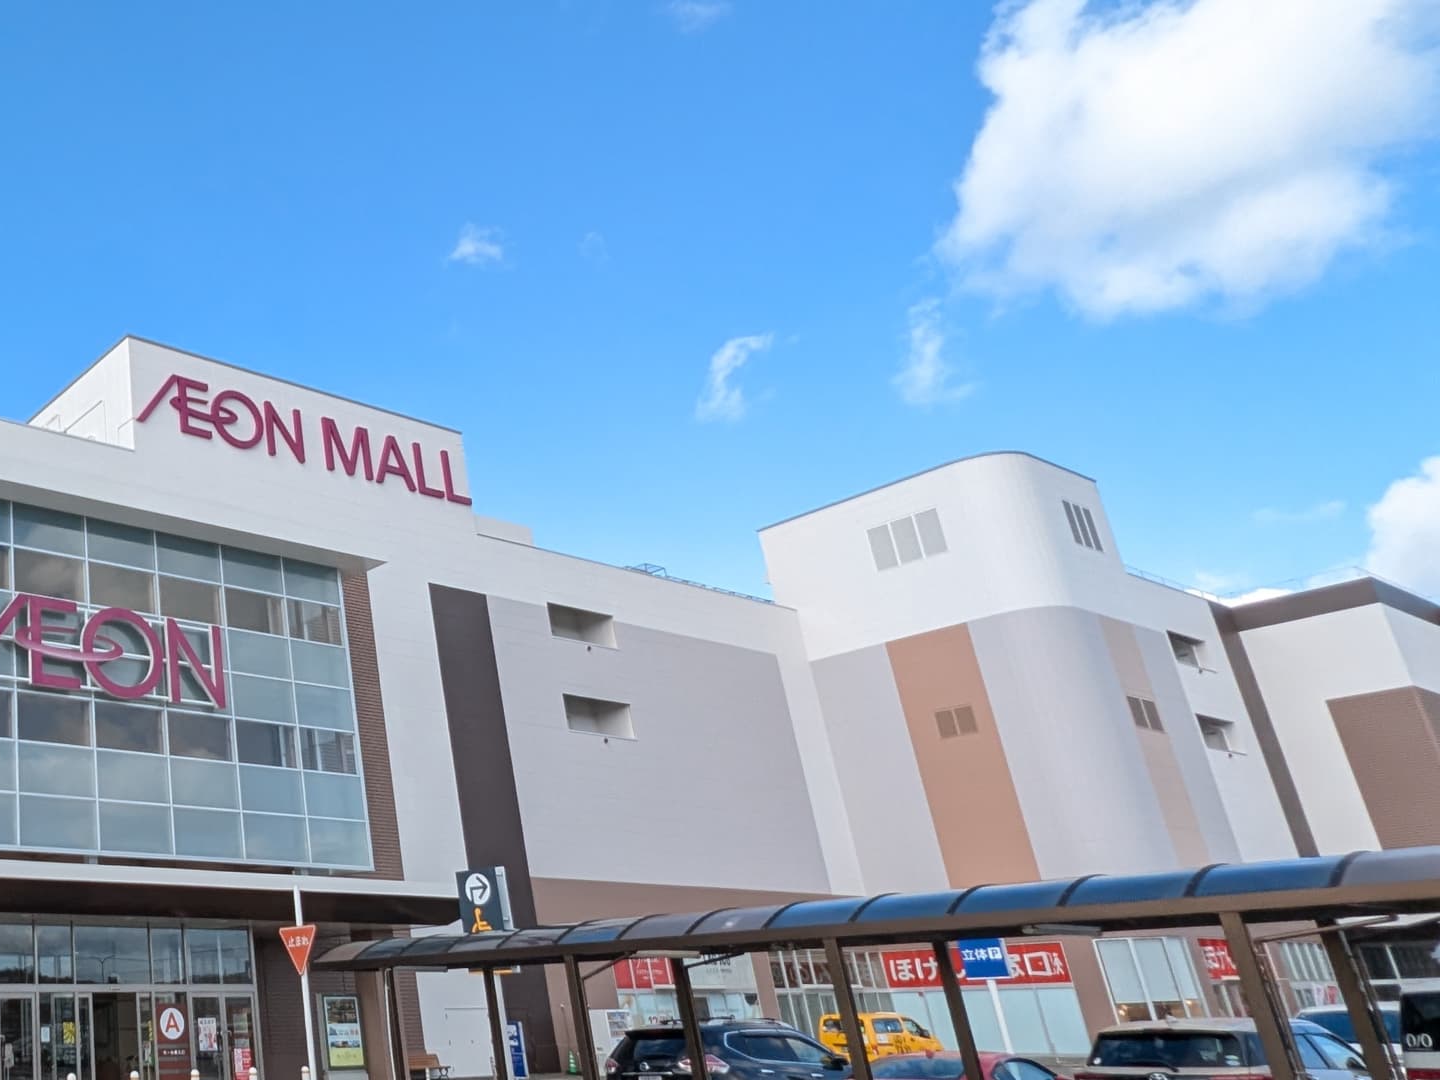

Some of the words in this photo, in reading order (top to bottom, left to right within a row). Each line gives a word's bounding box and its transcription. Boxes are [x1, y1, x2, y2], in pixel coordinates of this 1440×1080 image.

[321, 416, 472, 505] MALL
[288, 935, 310, 948] 止まれ
[165, 1011, 180, 1033] A
